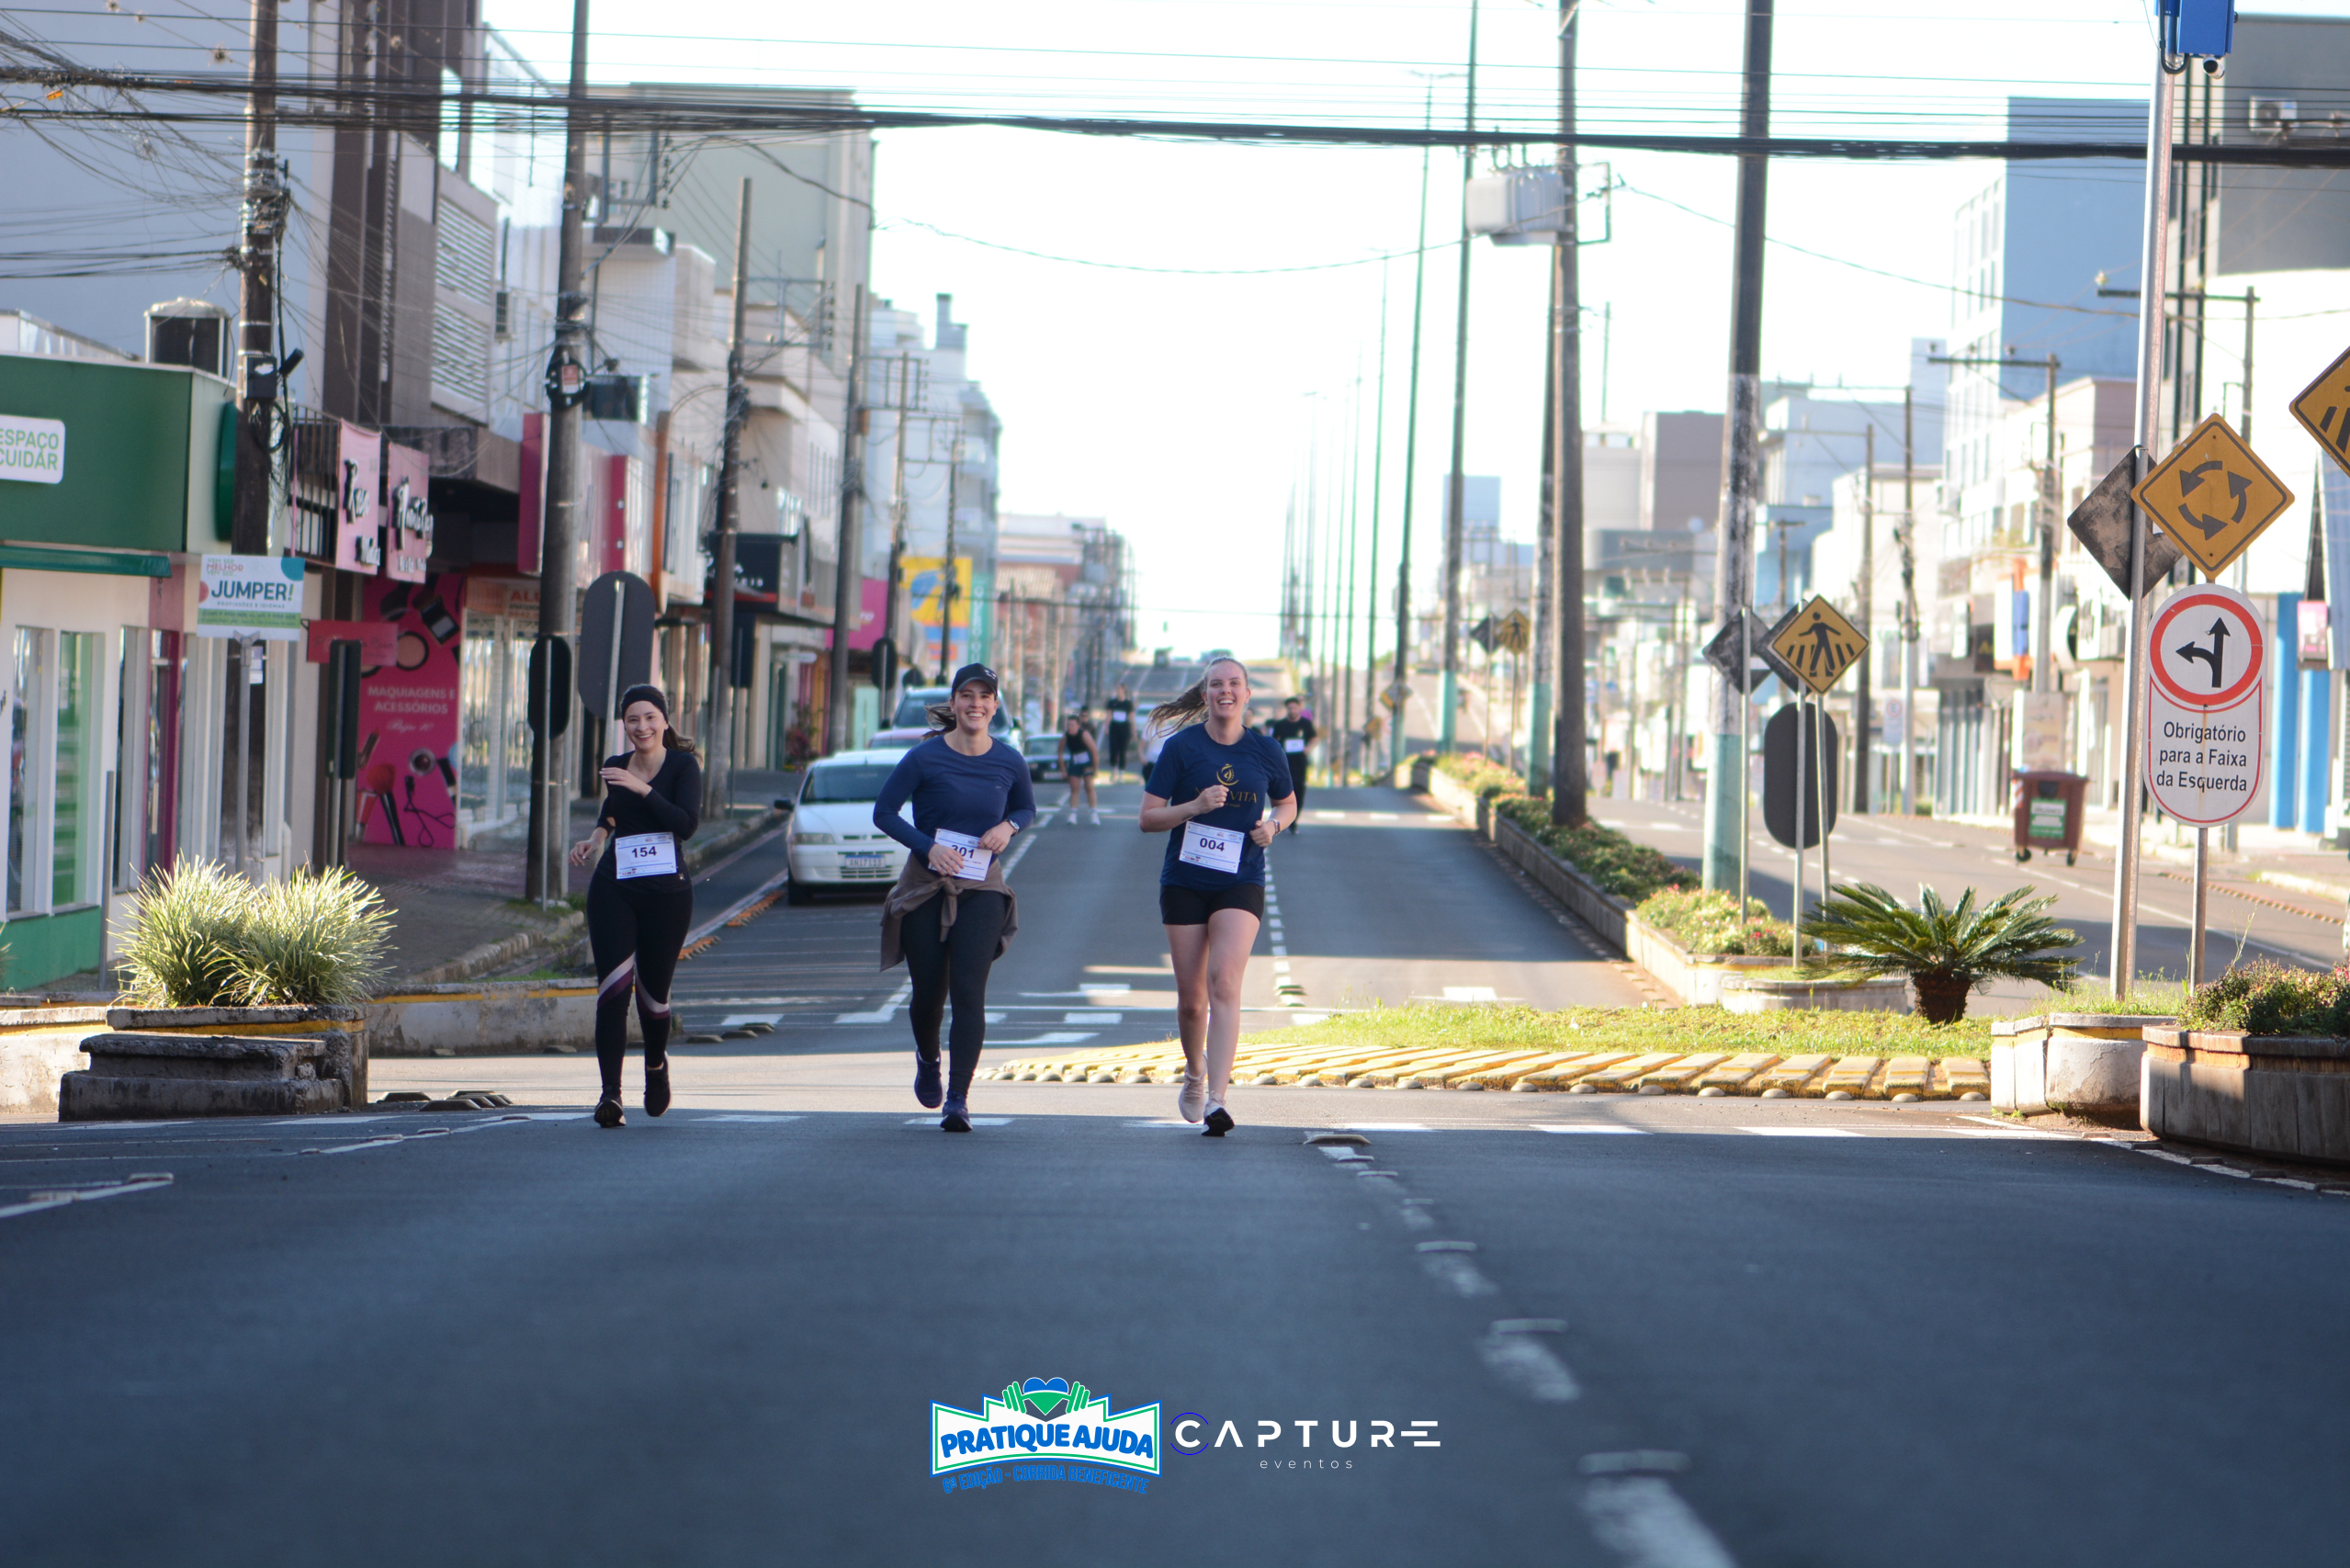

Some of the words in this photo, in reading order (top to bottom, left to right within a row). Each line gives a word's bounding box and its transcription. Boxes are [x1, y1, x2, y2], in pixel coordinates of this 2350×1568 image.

[207, 563, 244, 571] MELHOR
[211, 580, 295, 602] JUMPER!
[368, 686, 447, 699] MAQUIAGENS
[449, 690, 455, 699] E
[375, 701, 448, 714] ACESSÓRIOS
[2164, 721, 2246, 744] Obrigatório
[2159, 750, 2191, 766] para
[2196, 751, 2203, 764] a
[2209, 749, 2247, 767] Faixa
[2156, 770, 2174, 787] da
[2178, 771, 2247, 793] Esquerda
[631, 846, 657, 858] 154
[1200, 837, 1226, 852] 004
